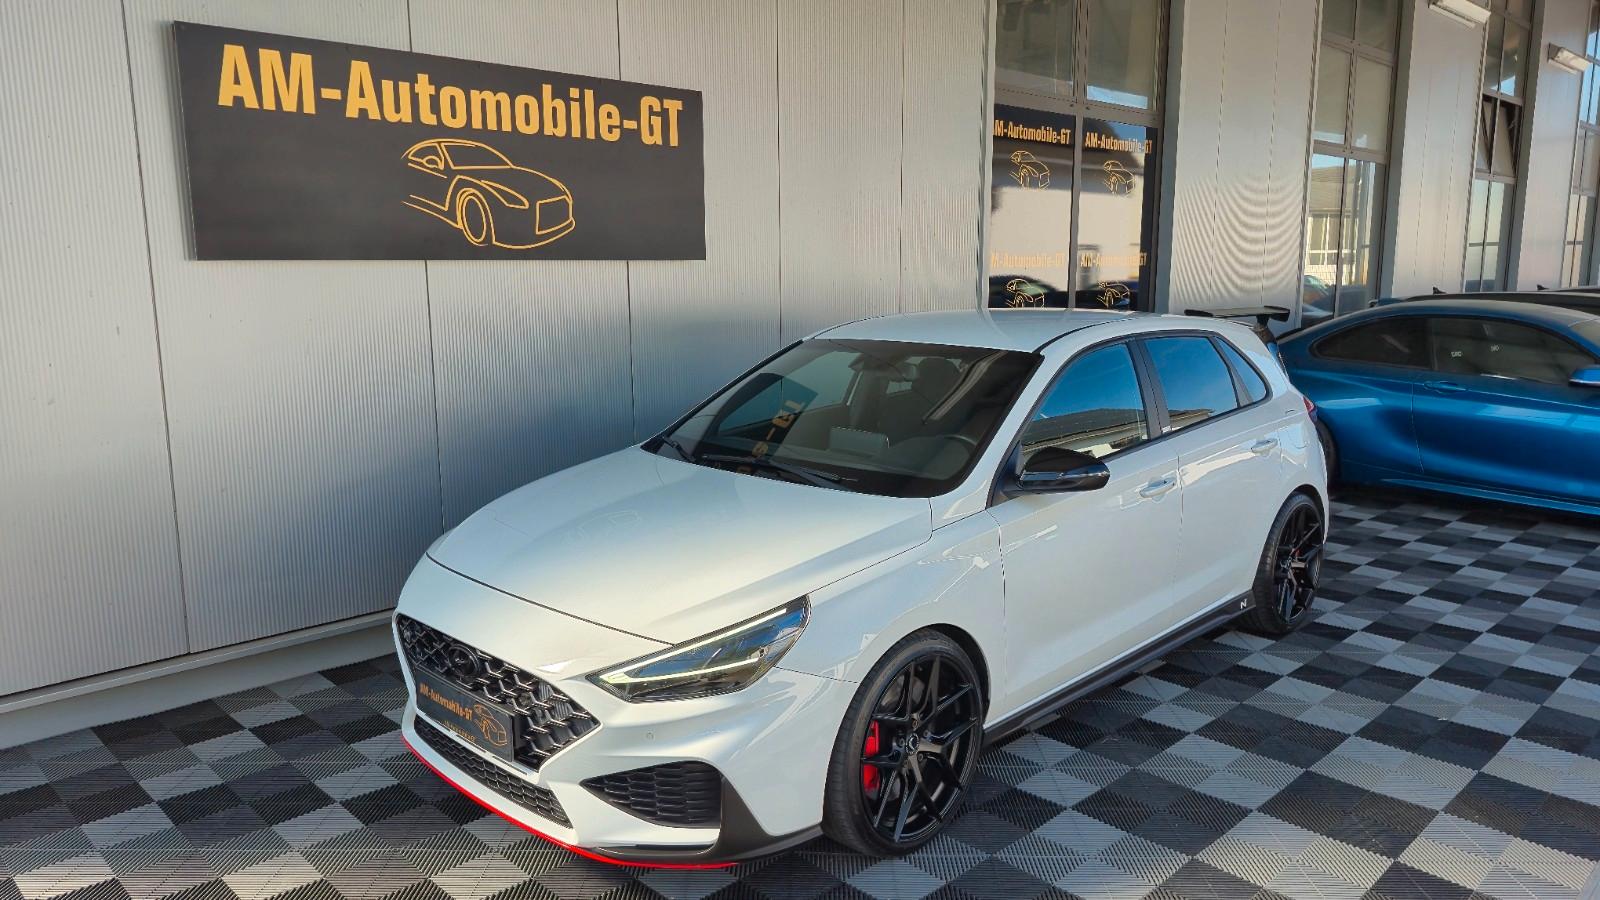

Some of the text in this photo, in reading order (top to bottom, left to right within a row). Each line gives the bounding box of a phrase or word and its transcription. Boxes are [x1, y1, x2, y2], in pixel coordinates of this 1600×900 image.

[218, 43, 683, 147] AM-Automobile-GT
[993, 120, 1071, 144] M-Automobile-GT
[1085, 132, 1152, 154] AM-Automobile-GT
[1240, 599, 1247, 609] N
